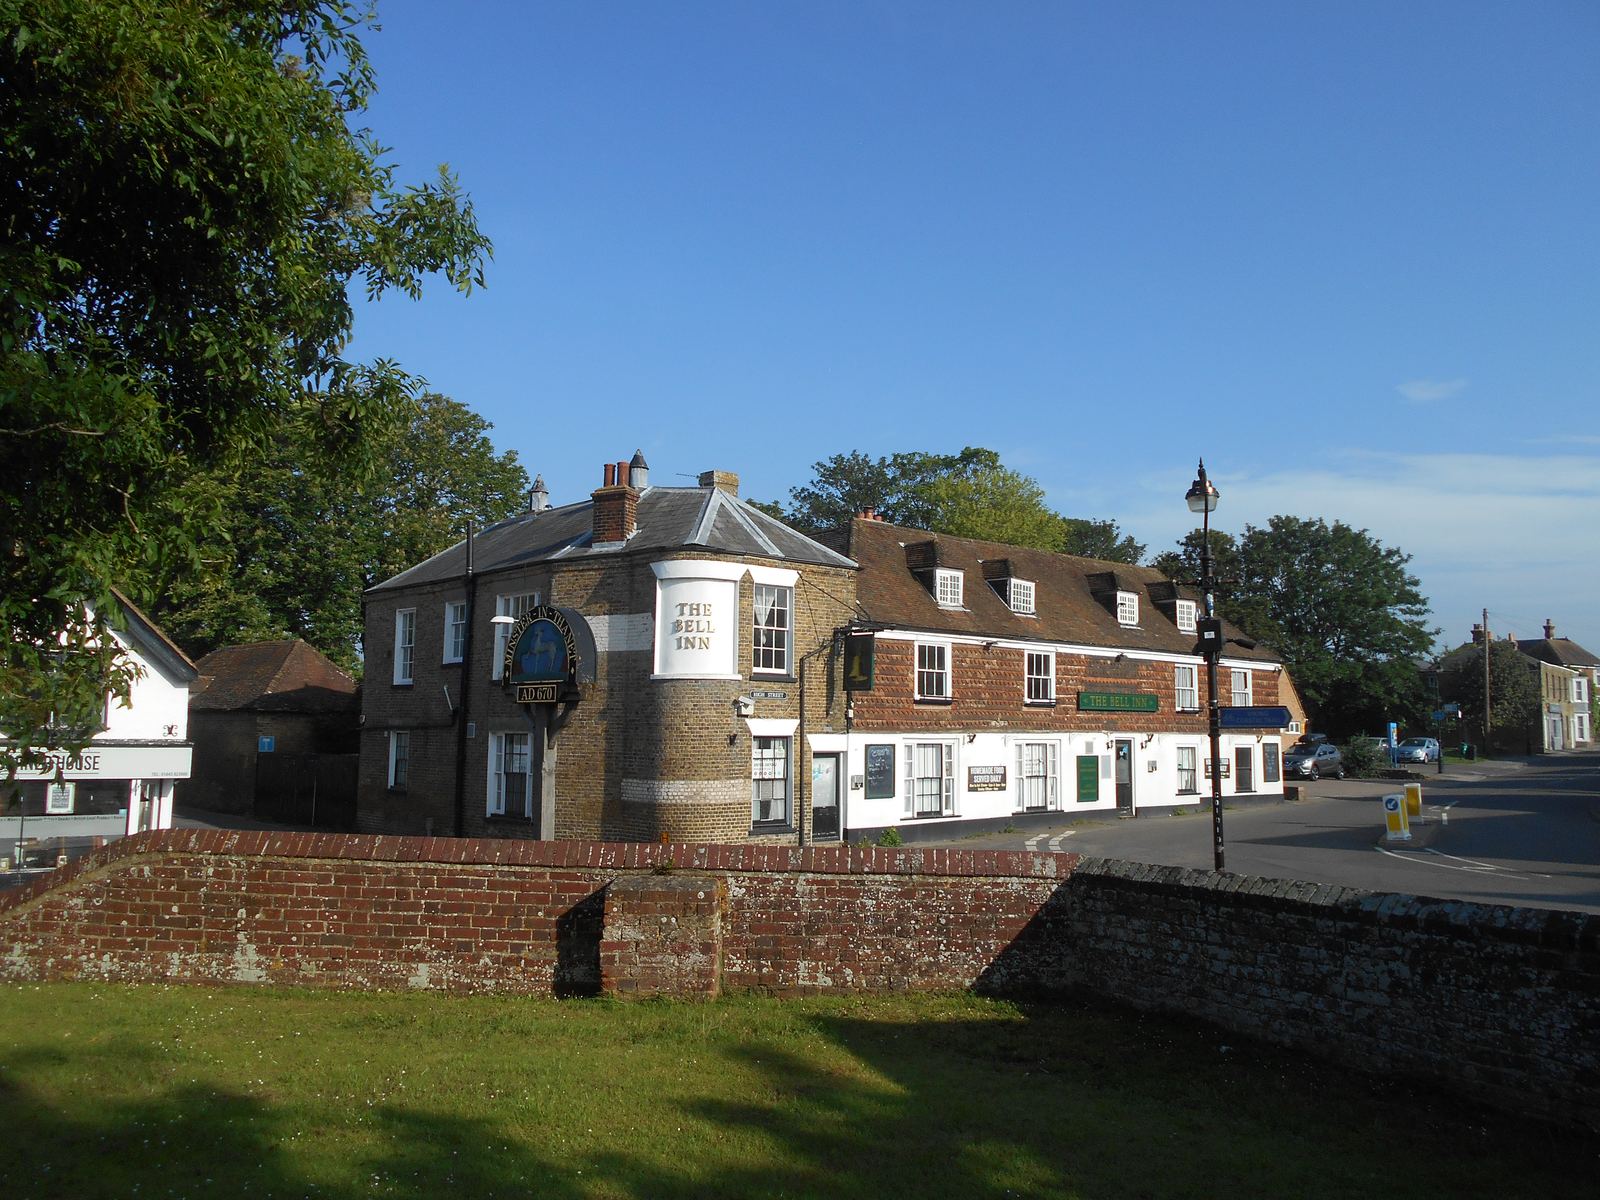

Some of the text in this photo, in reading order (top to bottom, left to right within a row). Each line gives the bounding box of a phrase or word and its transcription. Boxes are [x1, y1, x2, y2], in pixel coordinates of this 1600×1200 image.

[675, 602, 712, 617] THE
[671, 619, 715, 634] BELL
[675, 636, 710, 650] INN
[521, 687, 553, 701] AD 670
[1090, 695, 1147, 708] THE BELL INN
[57, 755, 101, 771] HOUSE
